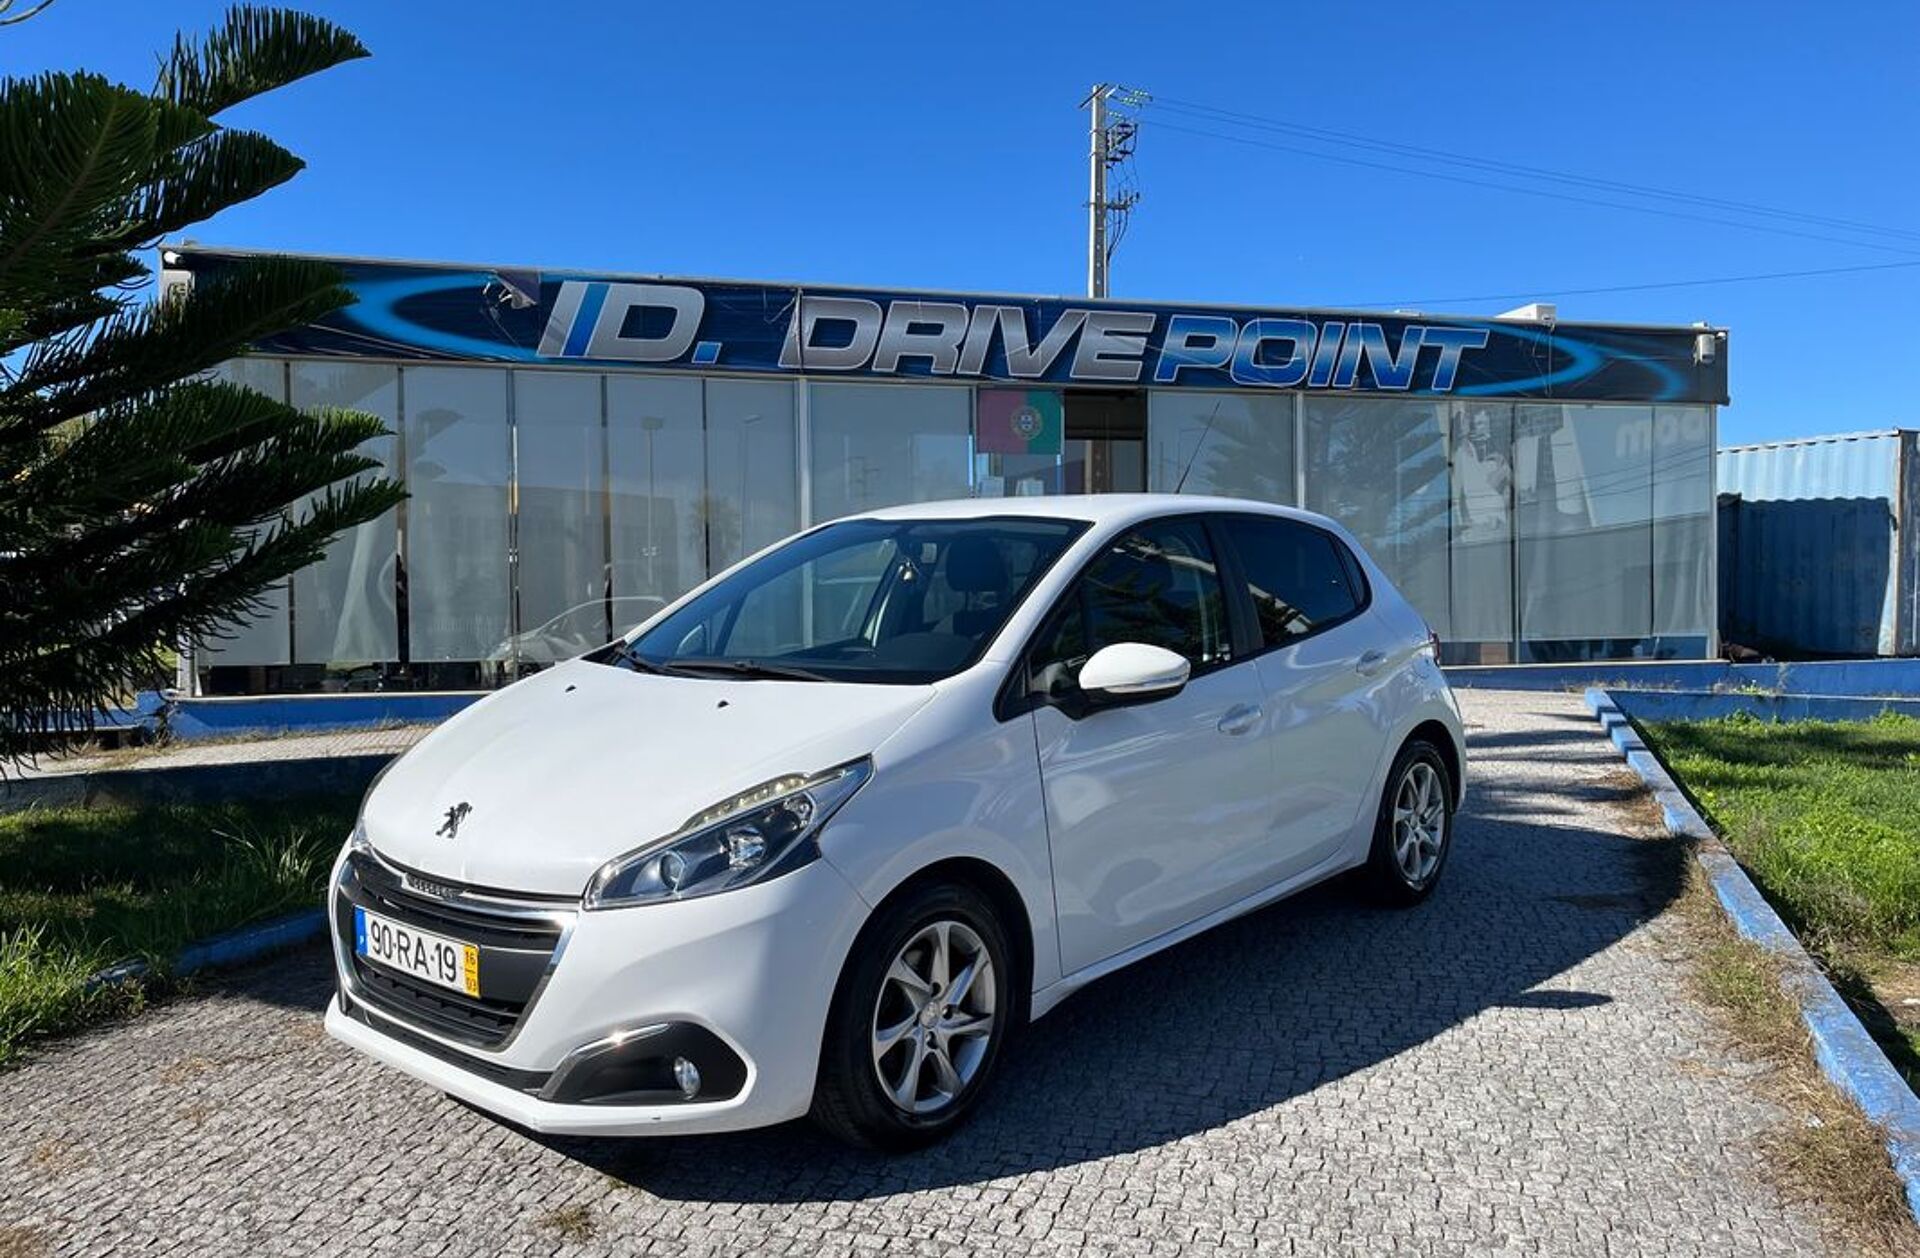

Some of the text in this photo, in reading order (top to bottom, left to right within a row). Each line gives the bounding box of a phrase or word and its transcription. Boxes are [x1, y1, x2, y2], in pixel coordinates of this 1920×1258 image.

[536, 279, 1490, 391] ID. DRIVE POINT
